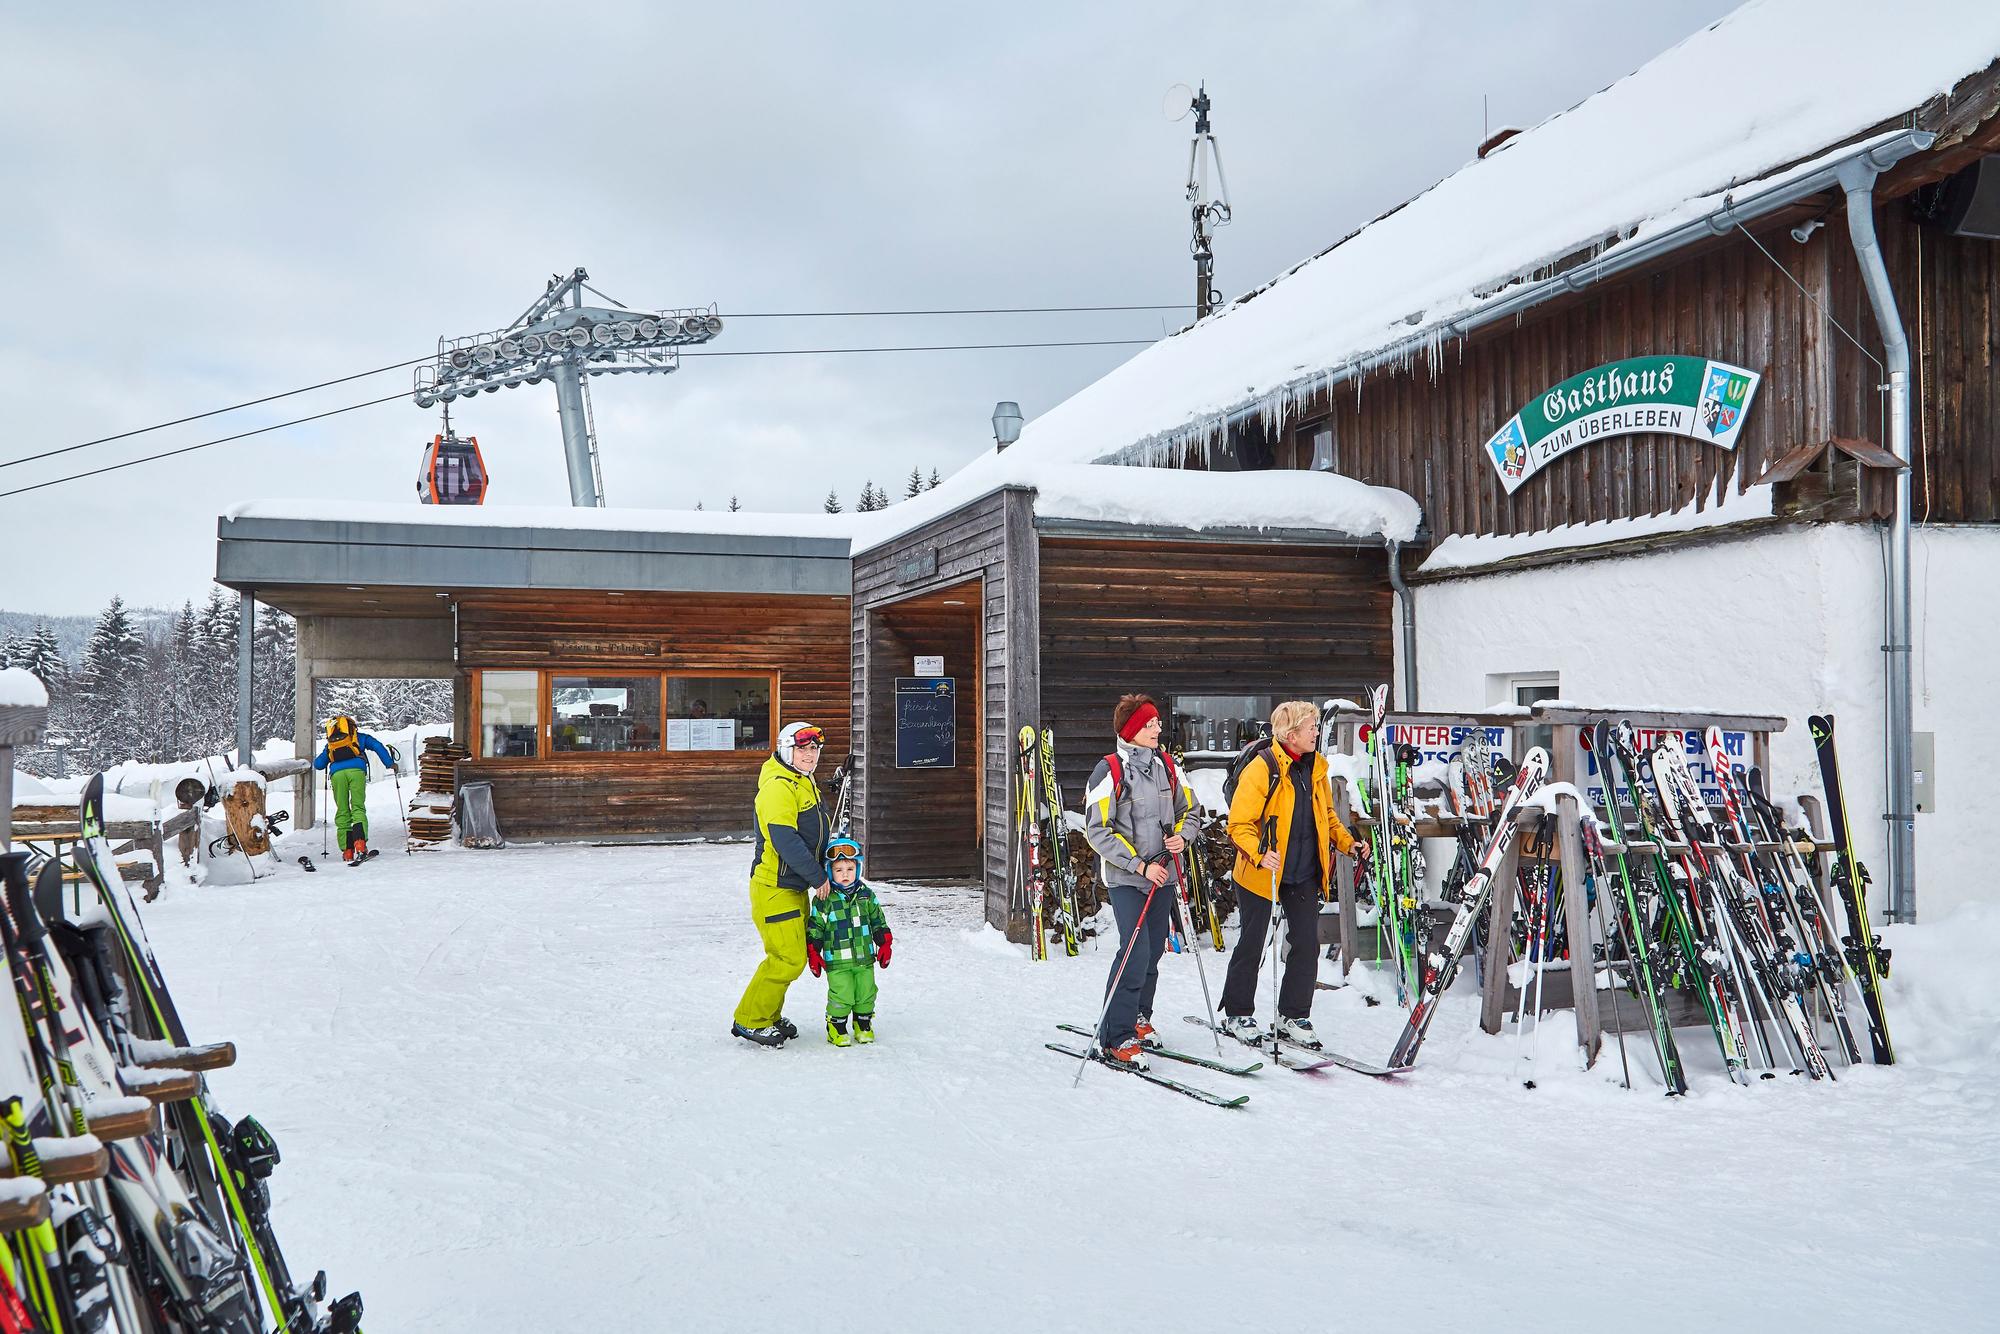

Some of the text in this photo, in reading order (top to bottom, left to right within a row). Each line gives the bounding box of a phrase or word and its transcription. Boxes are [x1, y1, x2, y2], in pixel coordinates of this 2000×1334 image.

[1543, 362, 1675, 423] Gasthaus
[1540, 410, 1683, 459] ZUM ÜBERLEBEN
[1394, 724, 1505, 747] INTERSPRT
[1041, 729, 1057, 805] FISCHER
